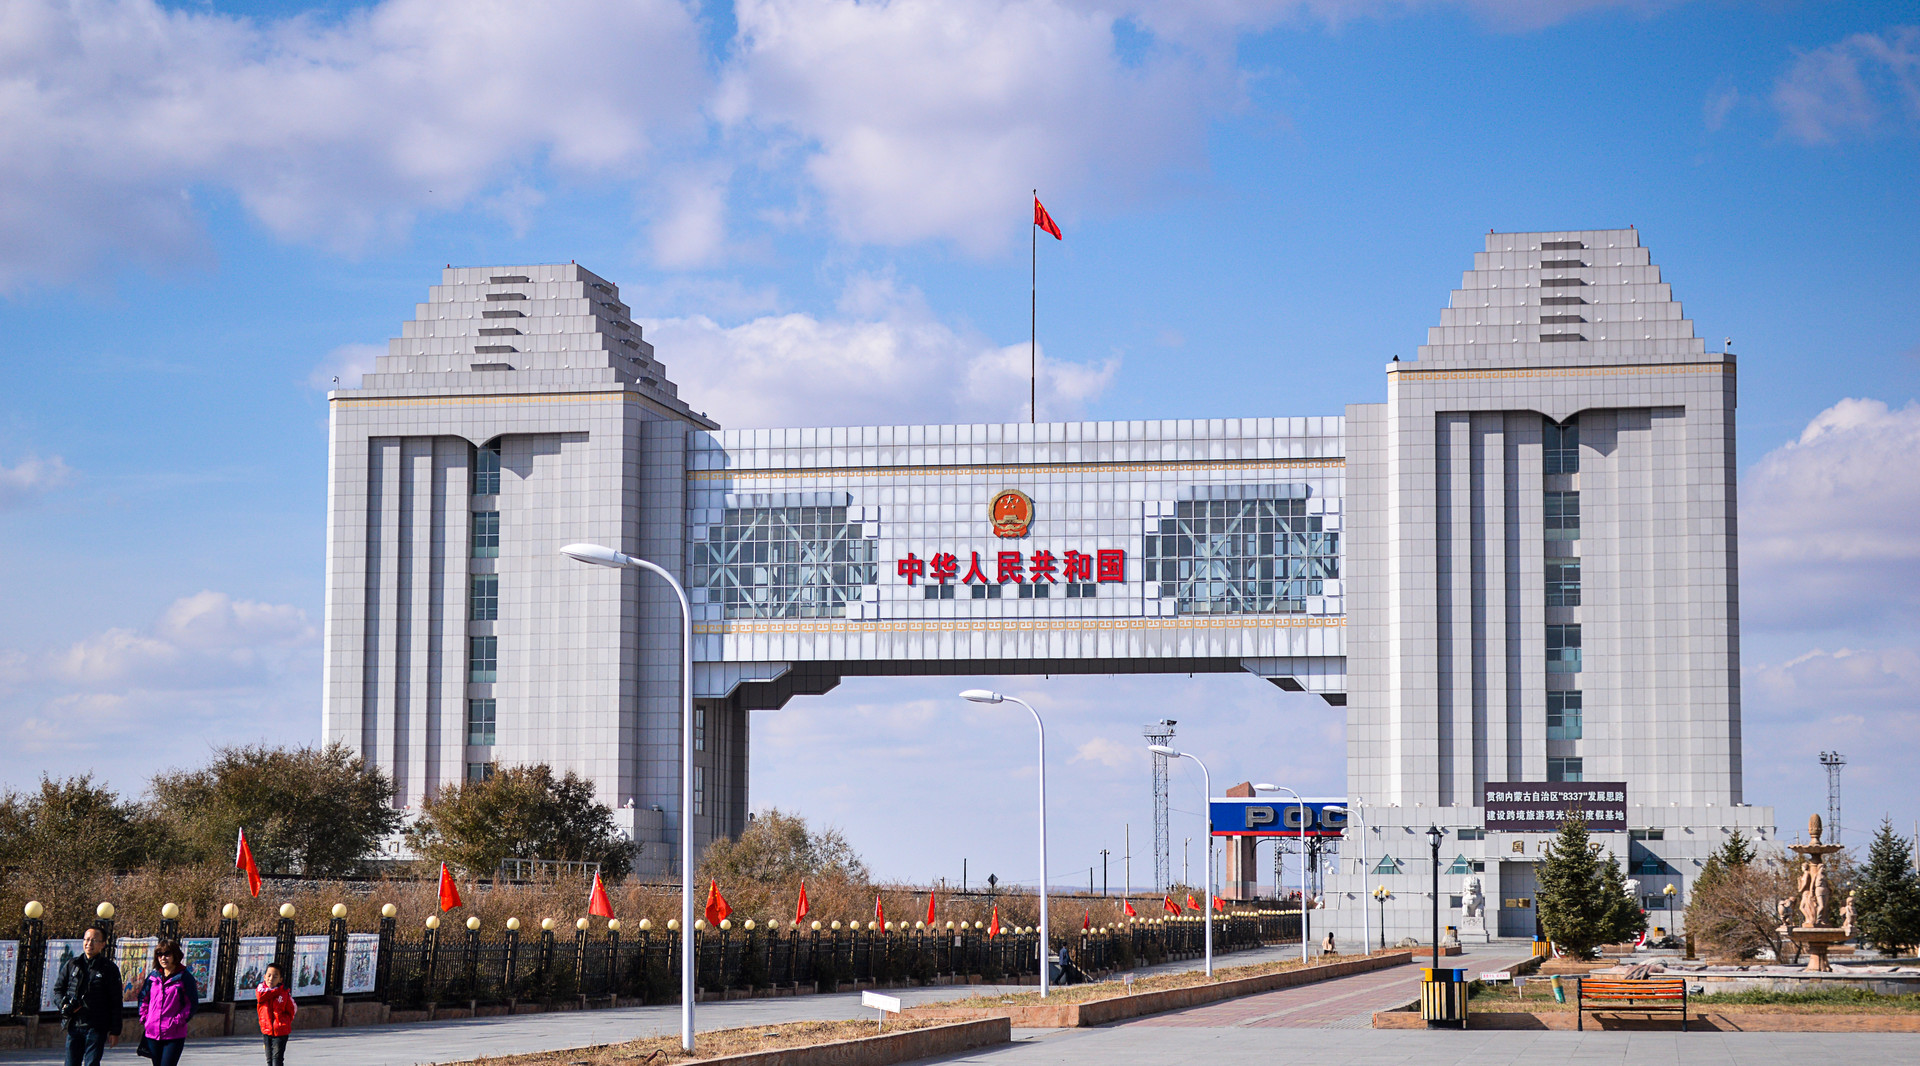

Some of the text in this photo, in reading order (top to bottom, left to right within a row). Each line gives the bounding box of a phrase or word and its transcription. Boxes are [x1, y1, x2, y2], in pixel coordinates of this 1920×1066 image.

[898, 549, 1125, 585] 中华人民共和国
